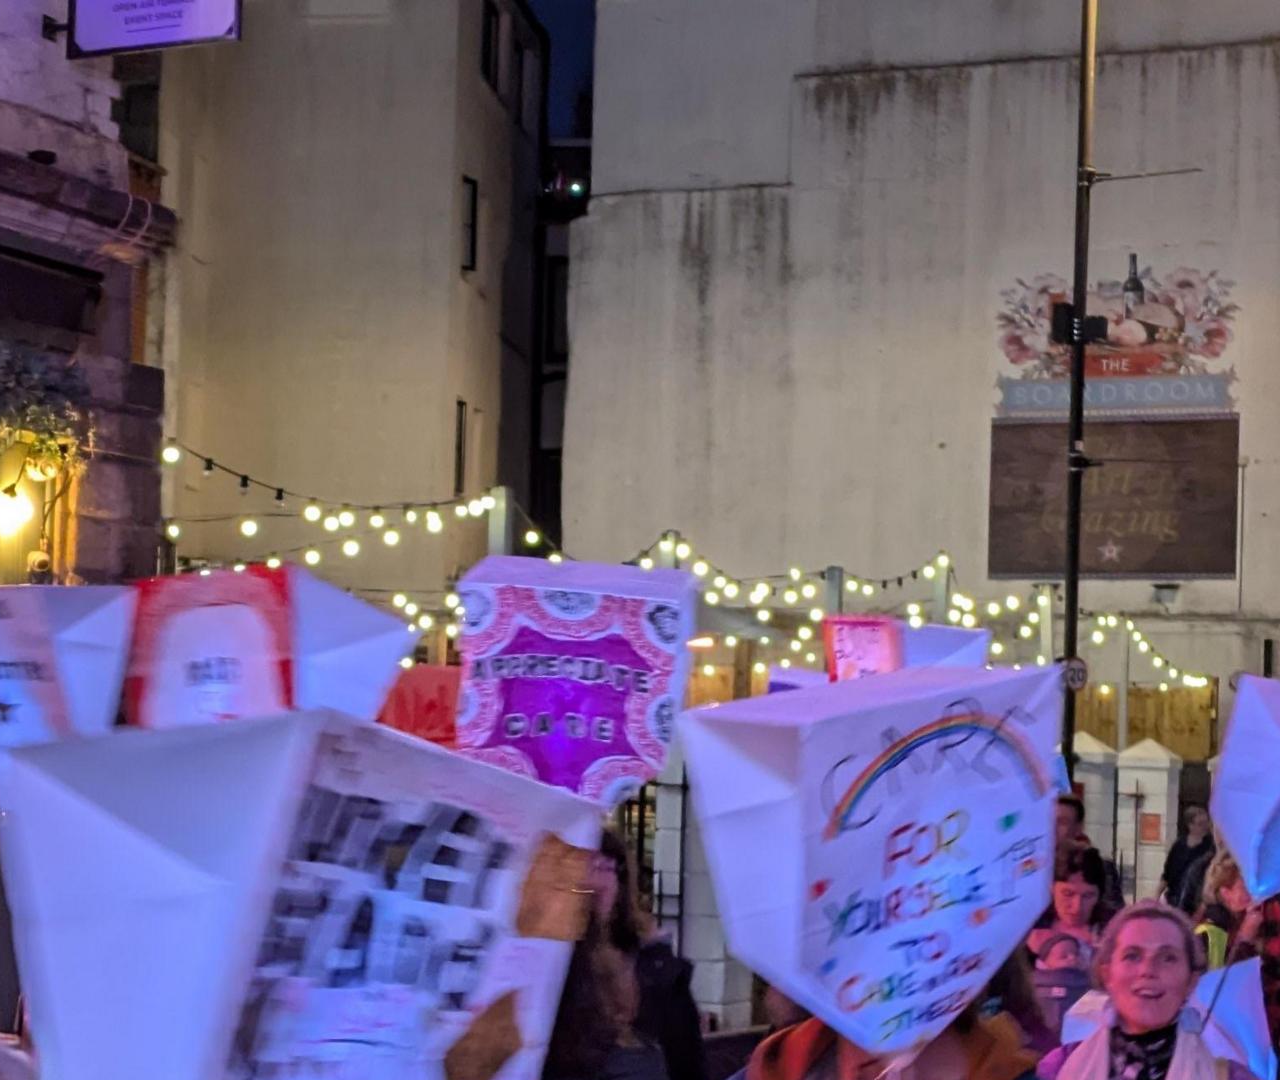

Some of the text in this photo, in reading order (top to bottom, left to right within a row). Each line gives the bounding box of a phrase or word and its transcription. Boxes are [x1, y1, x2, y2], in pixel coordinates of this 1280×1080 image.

[1101, 359, 1129, 372] THE
[475, 655, 649, 693] APPRECIATE
[821, 697, 1036, 831] CARE
[883, 810, 970, 880] FOR
[824, 865, 987, 945] YOURSELF
[889, 932, 951, 968] TO
